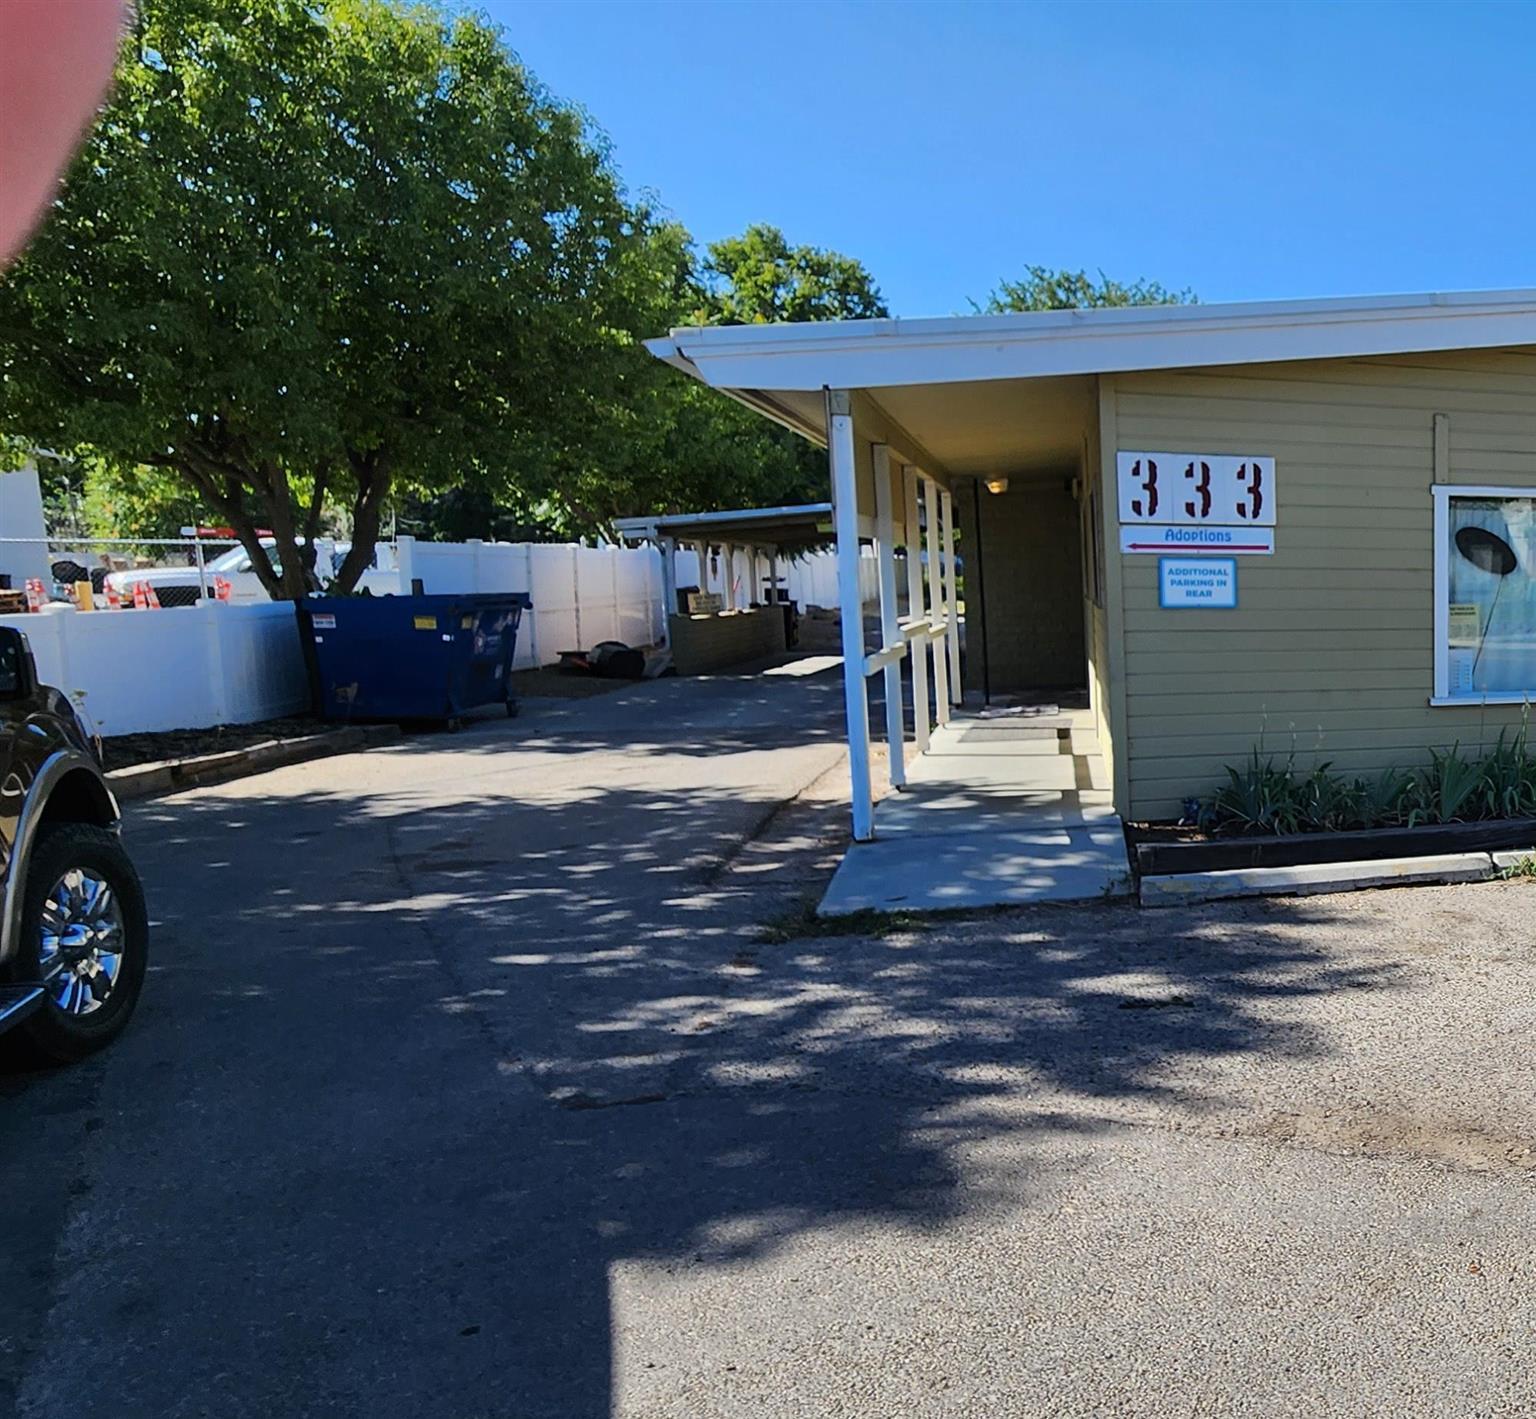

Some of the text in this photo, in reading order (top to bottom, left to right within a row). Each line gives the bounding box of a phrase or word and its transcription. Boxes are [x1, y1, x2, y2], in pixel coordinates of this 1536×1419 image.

[1164, 528, 1232, 543] Adoptions
[1168, 568, 1229, 576] ADDITIONAL
[1170, 579, 1227, 587] PARKING IN
[1185, 590, 1213, 598] REAR
